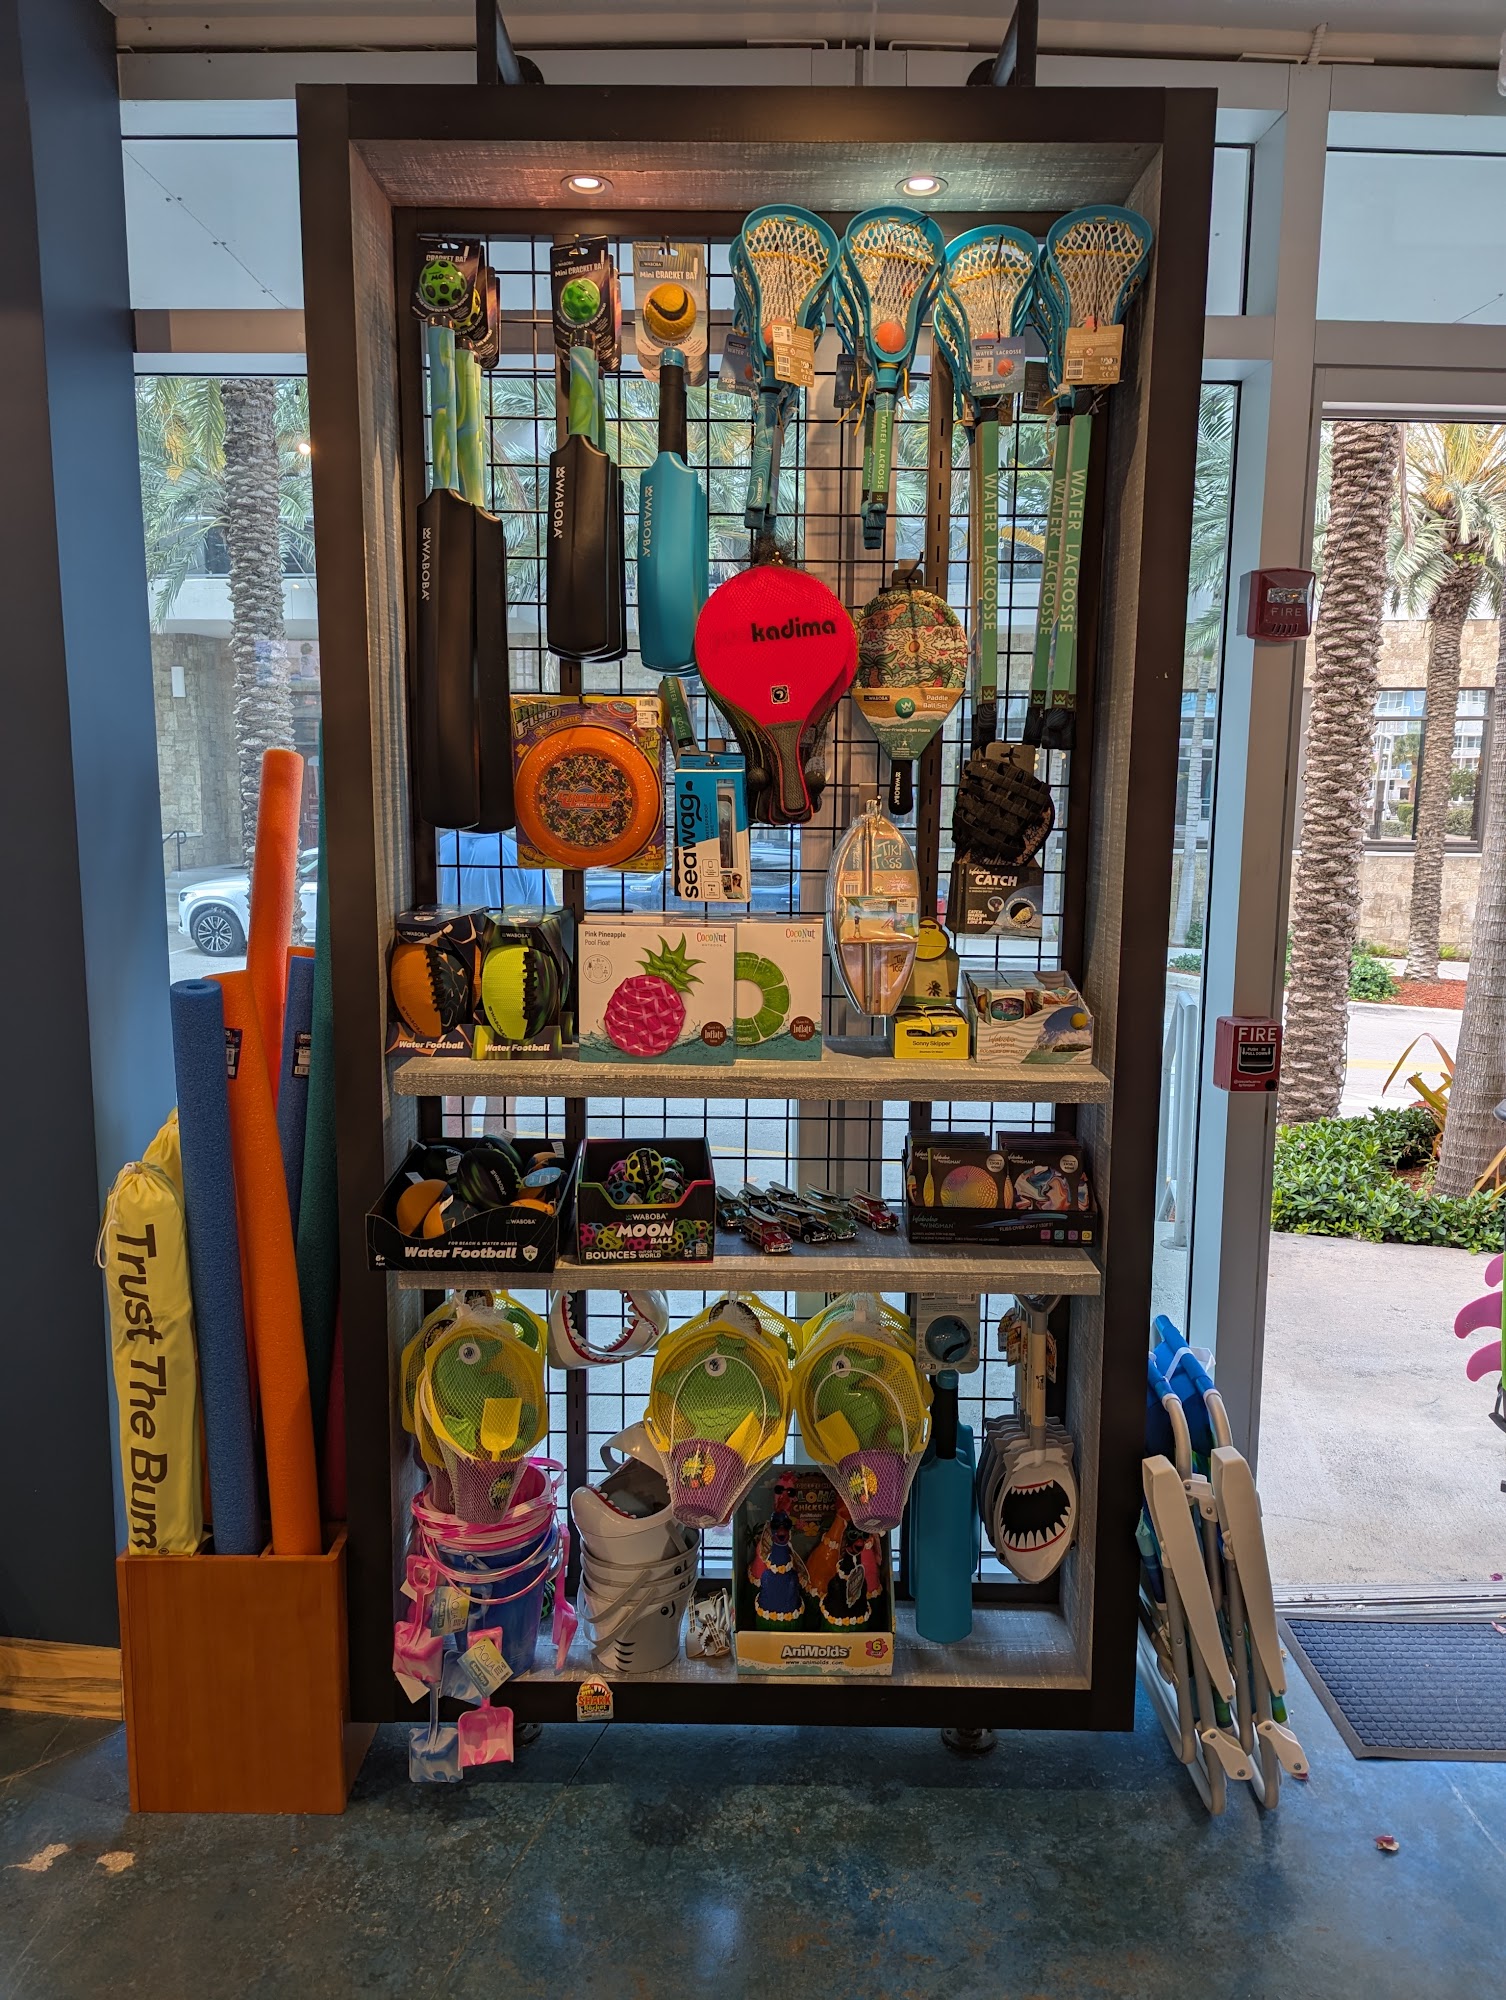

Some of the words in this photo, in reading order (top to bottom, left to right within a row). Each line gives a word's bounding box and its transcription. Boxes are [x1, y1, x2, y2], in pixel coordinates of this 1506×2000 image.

[555, 269, 568, 277] Mini
[568, 264, 593, 274] CRACKET
[655, 271, 683, 280] CRACKET
[685, 271, 697, 280] BAT
[727, 348, 744, 356] WATER
[880, 415, 888, 444] WATER
[878, 448, 886, 489] LACROSSE
[553, 478, 565, 539] WABOBA
[984, 473, 997, 532] WATER
[1050, 478, 1066, 537] WATER
[1068, 469, 1086, 530] WATER
[643, 496, 652, 557] WABOBA
[422, 538, 432, 600] WABOBA
[983, 545, 996, 631] LACROSSE
[1040, 550, 1059, 634] LACROSSE
[1060, 545, 1077, 632] LACROSSE
[1271, 607, 1303, 617] FIRE
[751, 616, 836, 643] kadima
[667, 679, 679, 704] WATER
[673, 704, 687, 737] LACROSSE
[679, 793, 703, 899] seawag
[975, 875, 1018, 886] CATCH
[697, 932, 727, 943] CocoNut
[785, 928, 815, 938] CocoNut
[793, 1024, 811, 1033] Inflate
[1239, 1027, 1277, 1041] FIRE
[399, 1040, 424, 1049] Water
[426, 1041, 464, 1049] Football
[484, 1044, 510, 1052] Water
[512, 1044, 551, 1052] Football
[616, 1220, 675, 1237] MOON
[375, 1254, 385, 1262] 6+
[404, 1246, 450, 1258] Water
[452, 1247, 517, 1259] Football
[586, 1251, 637, 1260] BOUNCES
[115, 1223, 164, 1345] Trust
[129, 1355, 167, 1439] The
[131, 1447, 168, 1549] Bum
[797, 1490, 837, 1503] LOHA
[781, 1645, 849, 1658] AniMolds
[872, 1641, 881, 1650] 6
[475, 1645, 496, 1671] AQUA
[578, 1694, 611, 1706] SHARK
